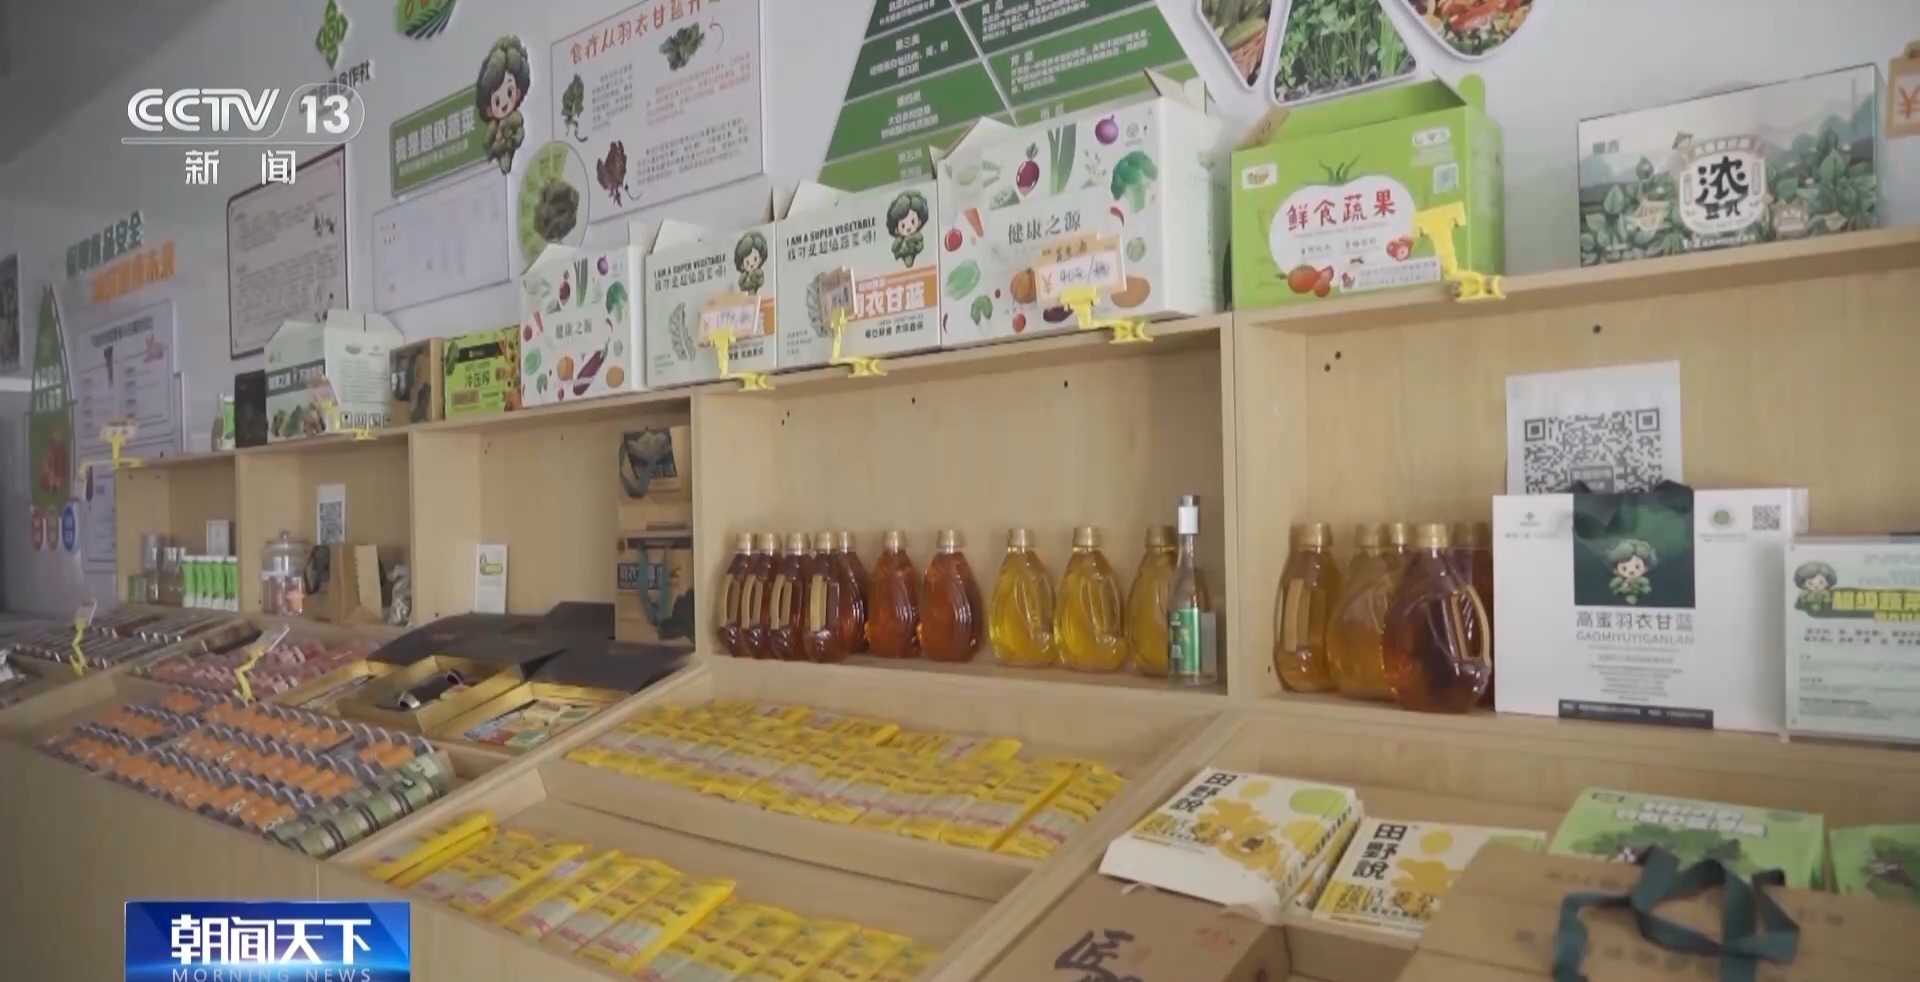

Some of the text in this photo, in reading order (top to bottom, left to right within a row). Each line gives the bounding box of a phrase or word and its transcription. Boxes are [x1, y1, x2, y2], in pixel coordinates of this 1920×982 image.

[570, 0, 720, 65] 食疗从羽衣甘蓝开
[1695, 155, 1750, 205] 浓
[810, 227, 834, 242] SUPER
[835, 217, 876, 235] VEGETABLE
[1008, 209, 1081, 245] 健康之源
[1286, 188, 1397, 232] 鲜食蔬果
[693, 253, 726, 270] VEGETABLE
